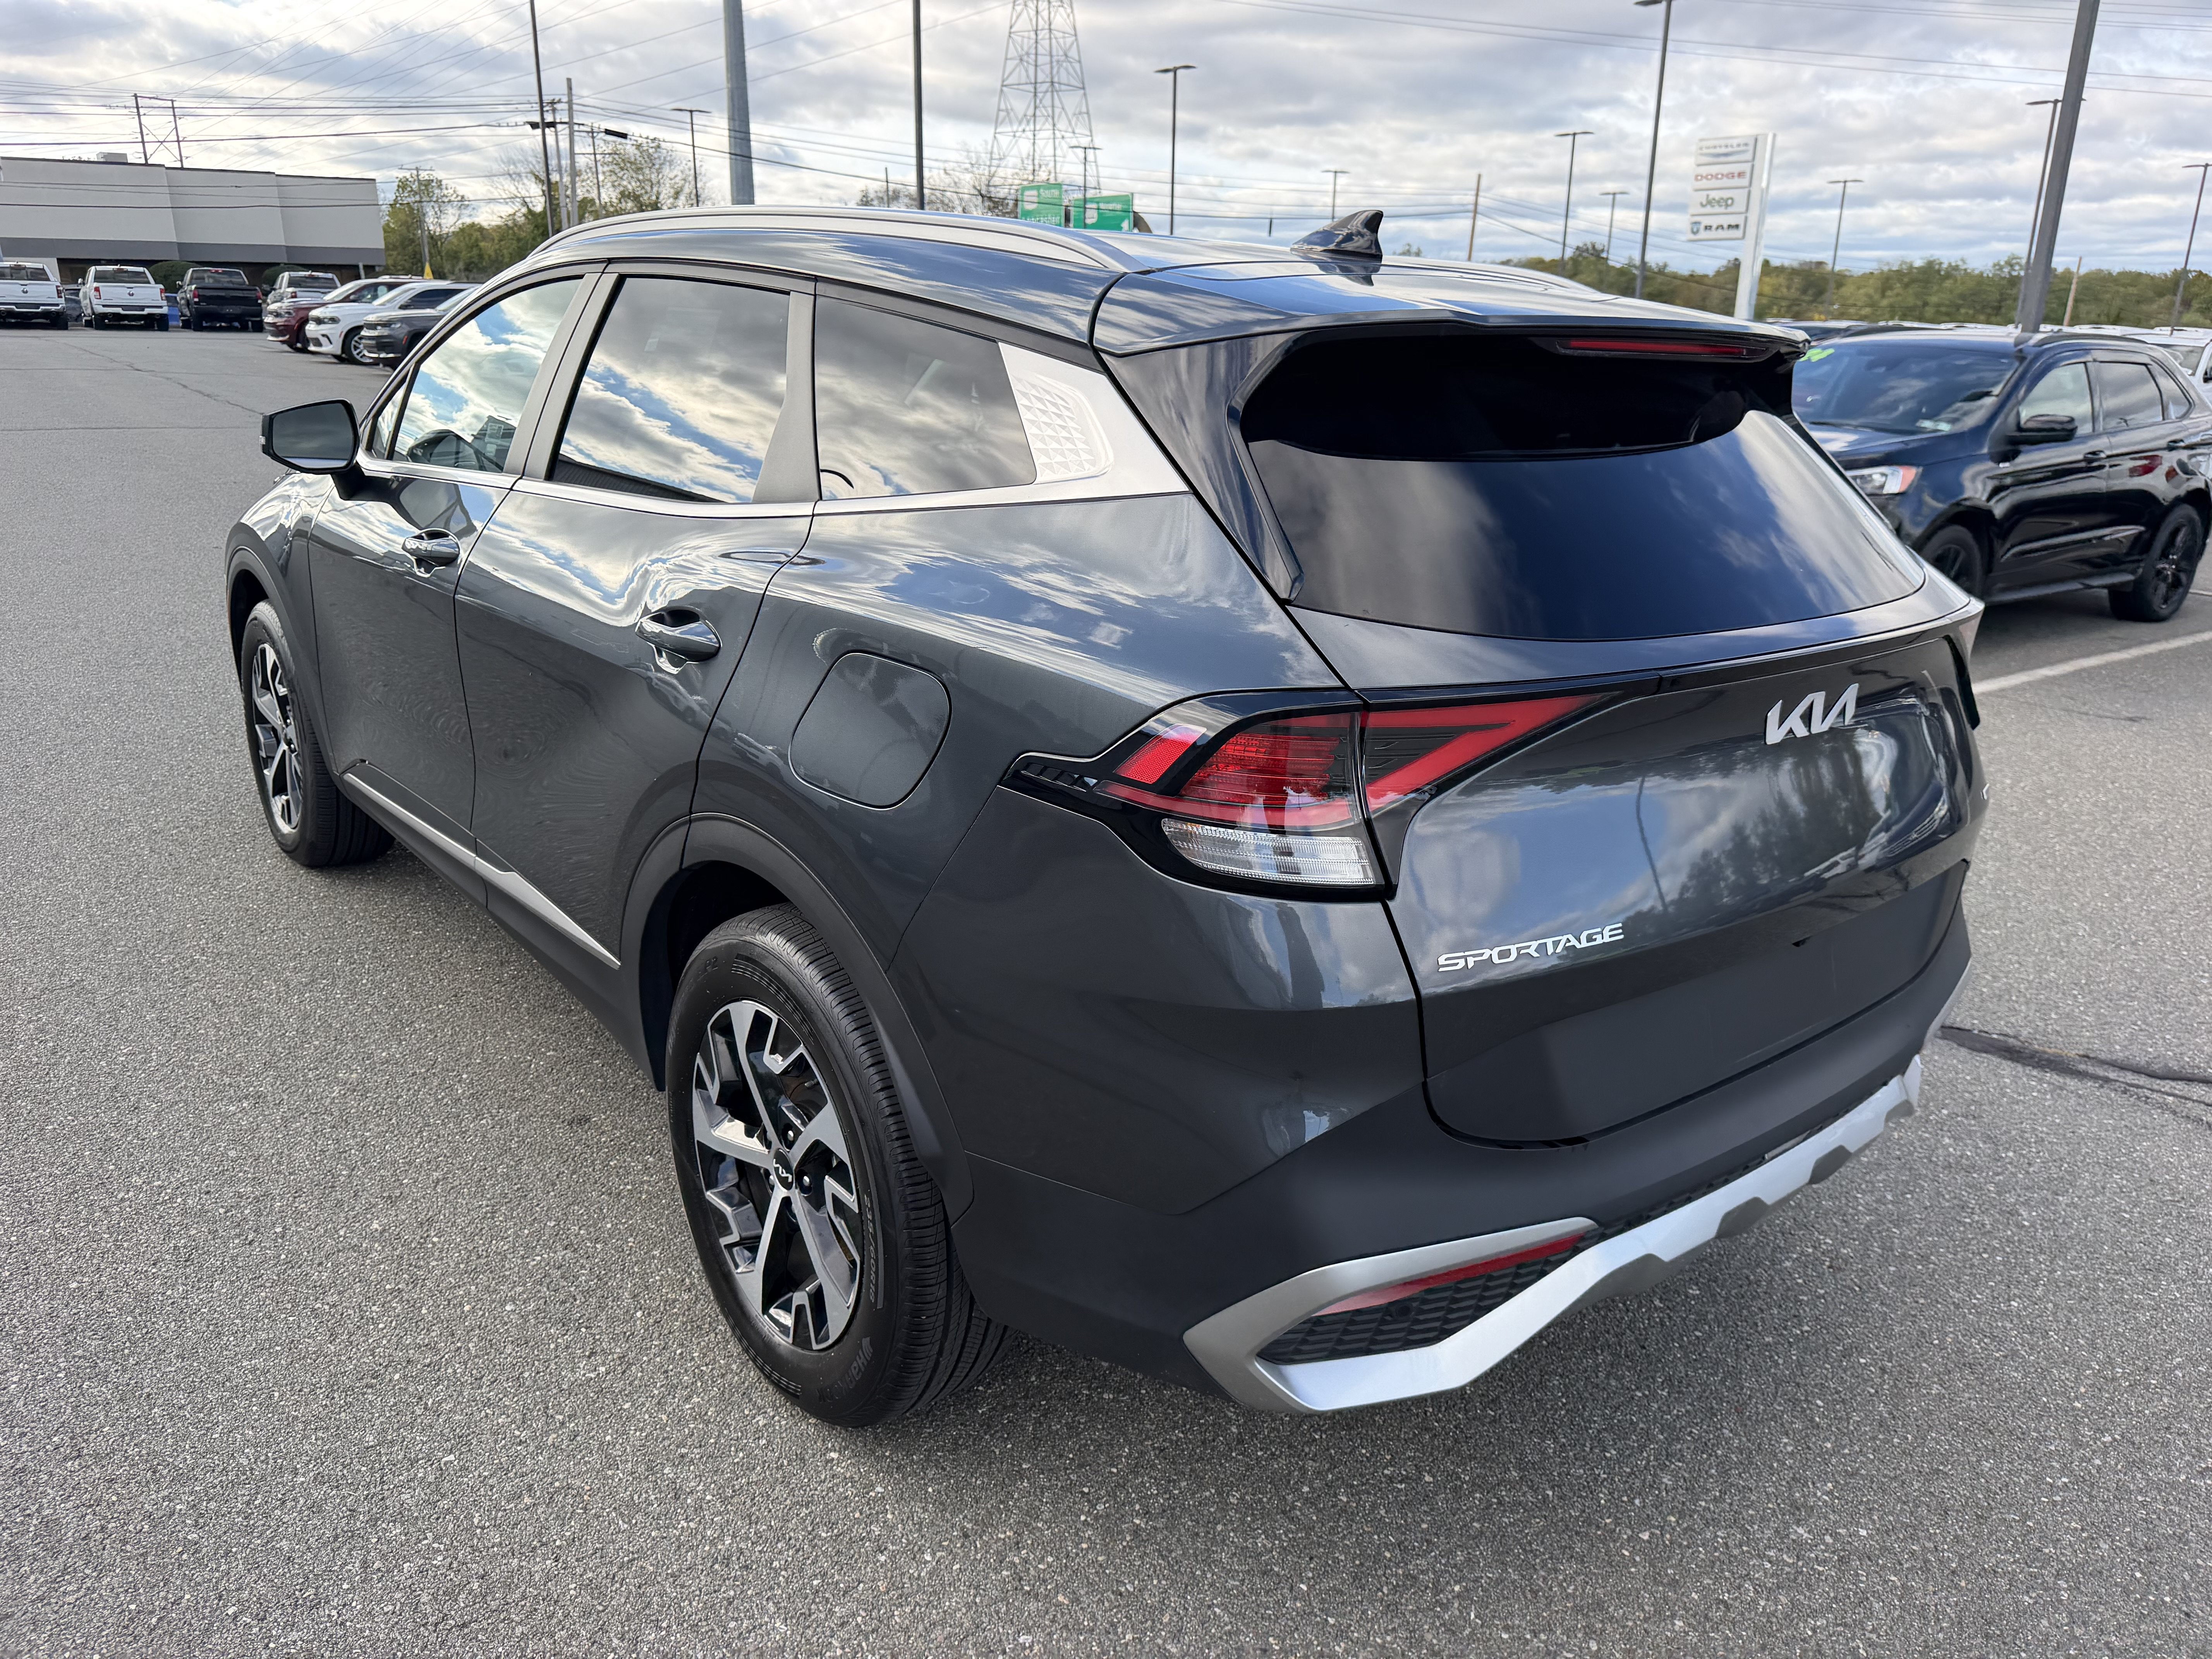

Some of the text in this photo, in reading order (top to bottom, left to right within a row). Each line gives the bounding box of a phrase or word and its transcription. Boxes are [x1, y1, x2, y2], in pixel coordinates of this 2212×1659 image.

[1694, 171, 1747, 182] DODGE
[1700, 194, 1734, 210] Jeep
[1765, 683, 1859, 745] KIA
[1437, 923, 1624, 972] SPORTAGE
[864, 1194, 876, 1303] 235/60R18
